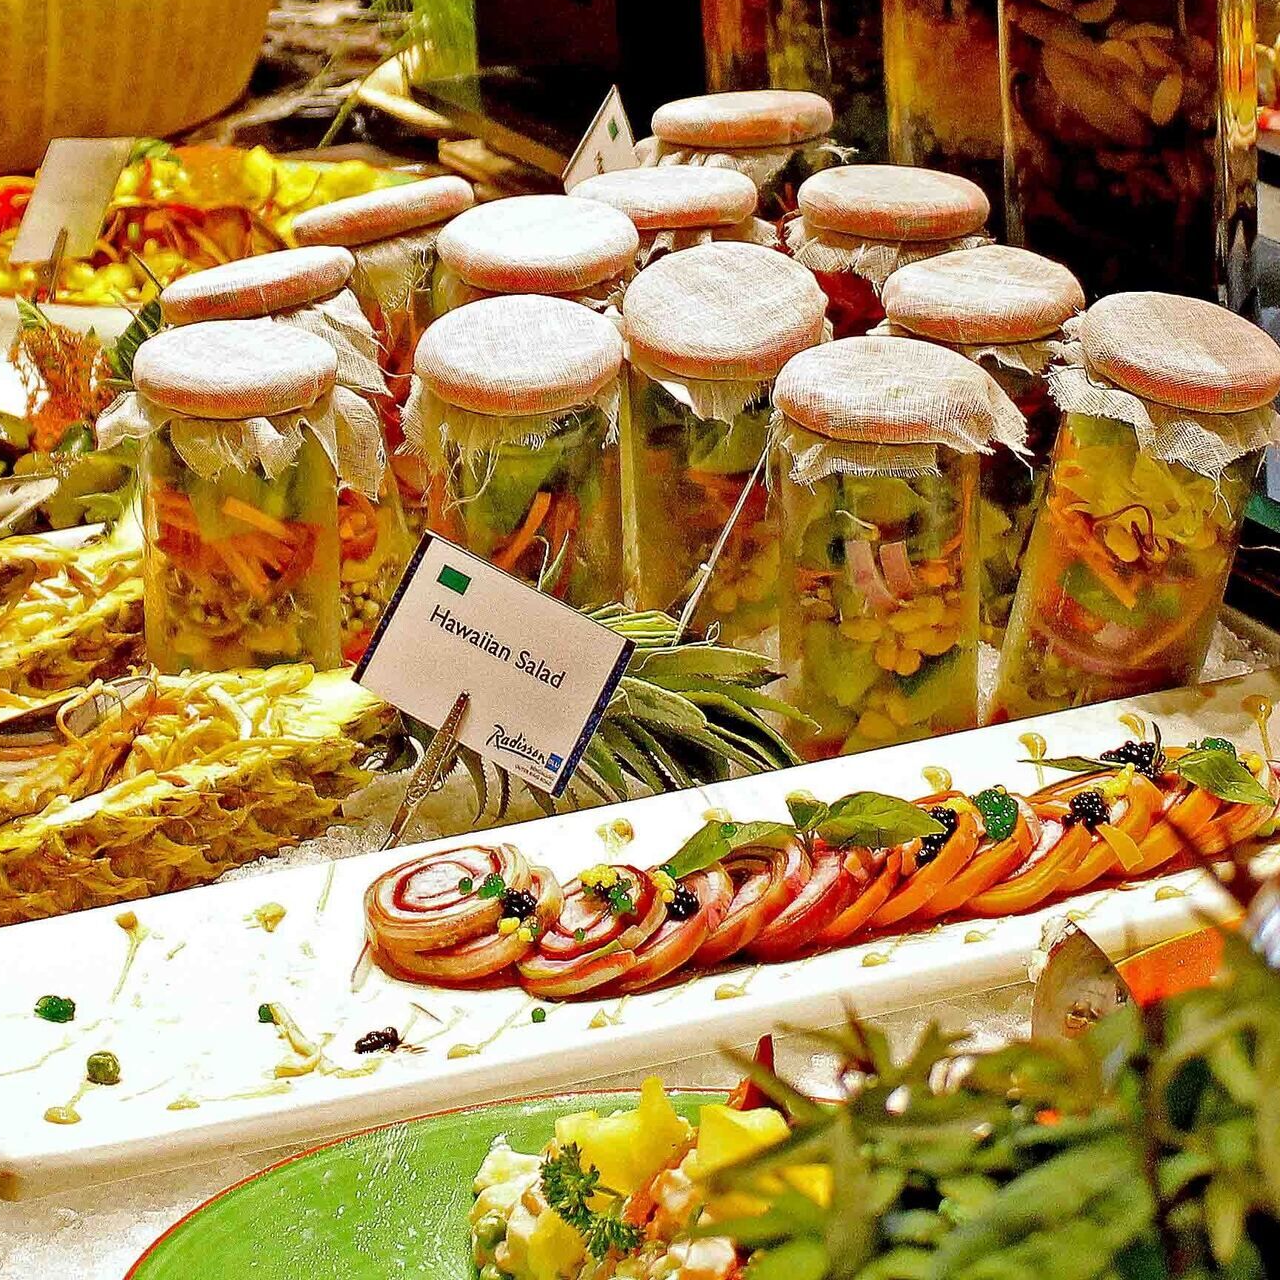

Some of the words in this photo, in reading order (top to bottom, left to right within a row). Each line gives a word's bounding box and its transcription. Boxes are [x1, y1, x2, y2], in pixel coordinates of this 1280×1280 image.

[429, 604, 512, 662] Hawaiian
[514, 649, 567, 690] Salad
[485, 723, 546, 765] Radisson
